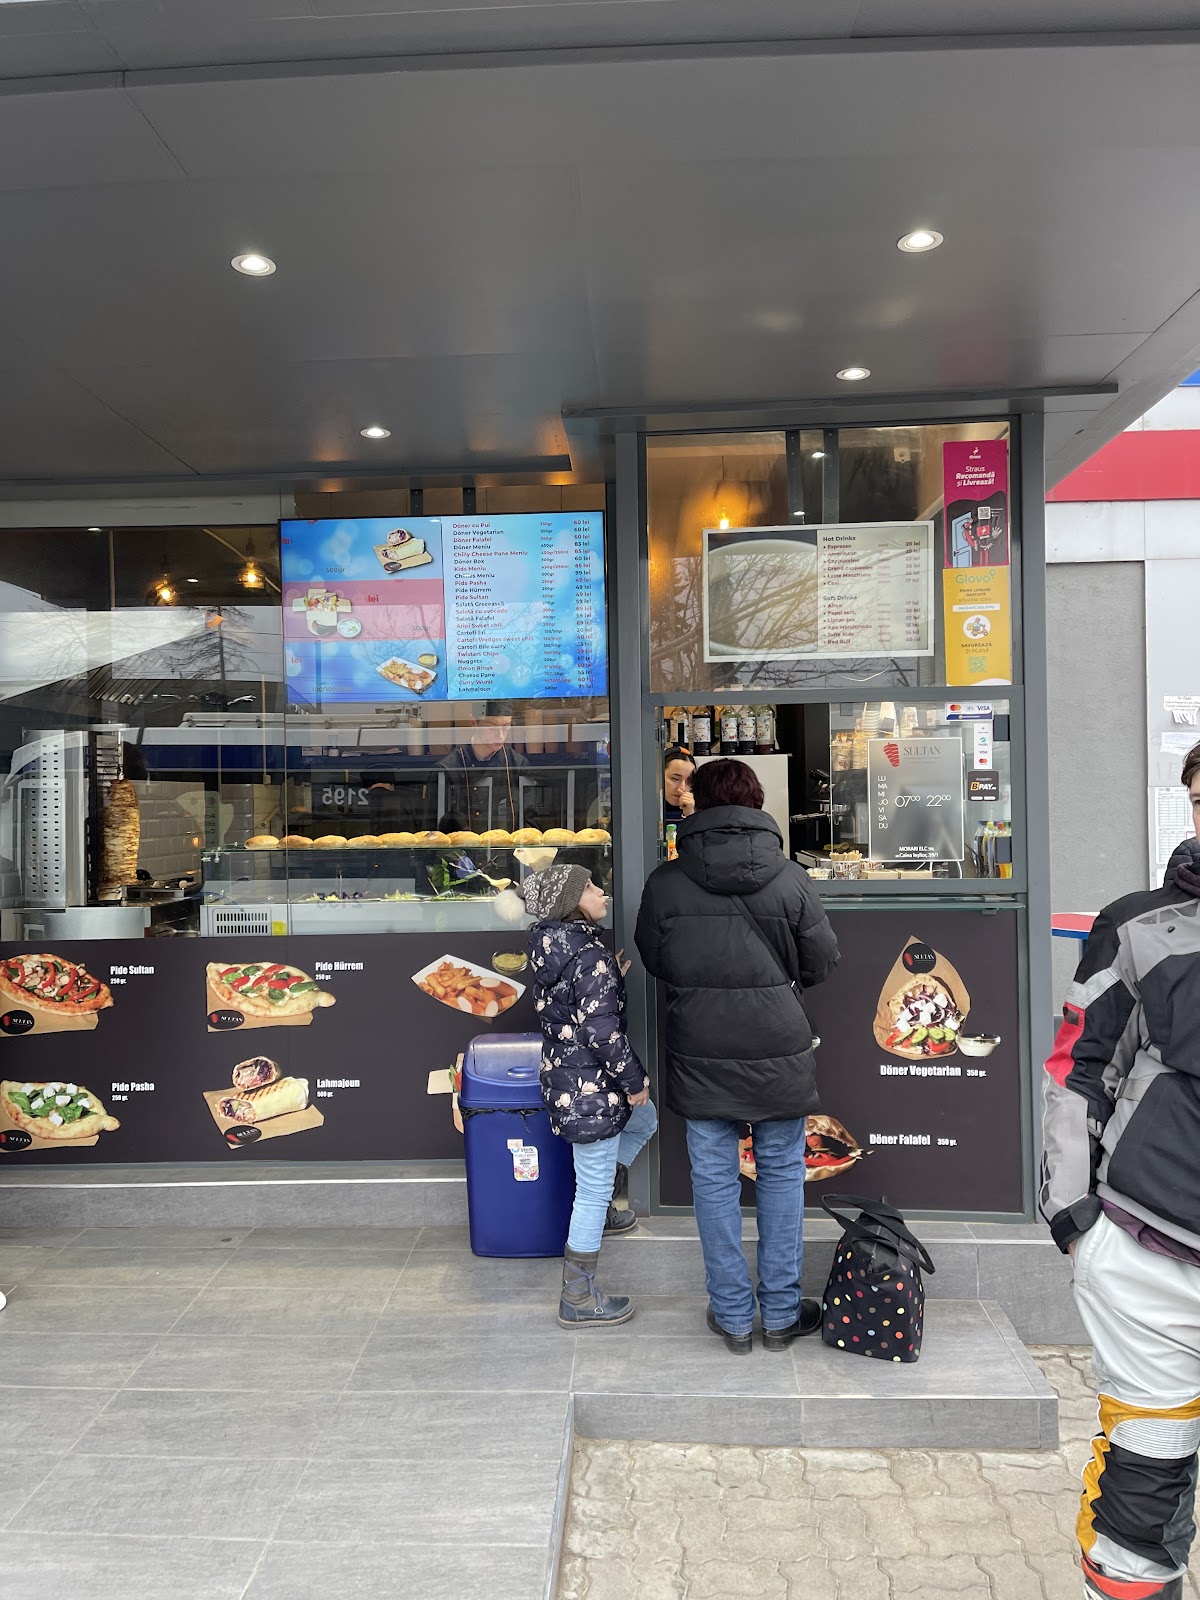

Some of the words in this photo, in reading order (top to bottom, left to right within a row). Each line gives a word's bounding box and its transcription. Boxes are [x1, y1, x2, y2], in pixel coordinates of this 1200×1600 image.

[956, 574, 990, 584] Glovo
[904, 747, 940, 755] SULTAN
[110, 966, 128, 974] Pide
[129, 965, 154, 974] Sultan
[316, 962, 332, 970] Pide
[334, 962, 363, 970] Hürrem
[880, 1065, 908, 1076] Döner
[909, 1066, 961, 1077] Vegetarian
[112, 1083, 129, 1091] Pide
[131, 1082, 154, 1091] Pasha
[317, 1079, 360, 1088] Lahmajoun
[870, 1134, 898, 1144] Döner
[899, 1134, 930, 1145] Falafel
